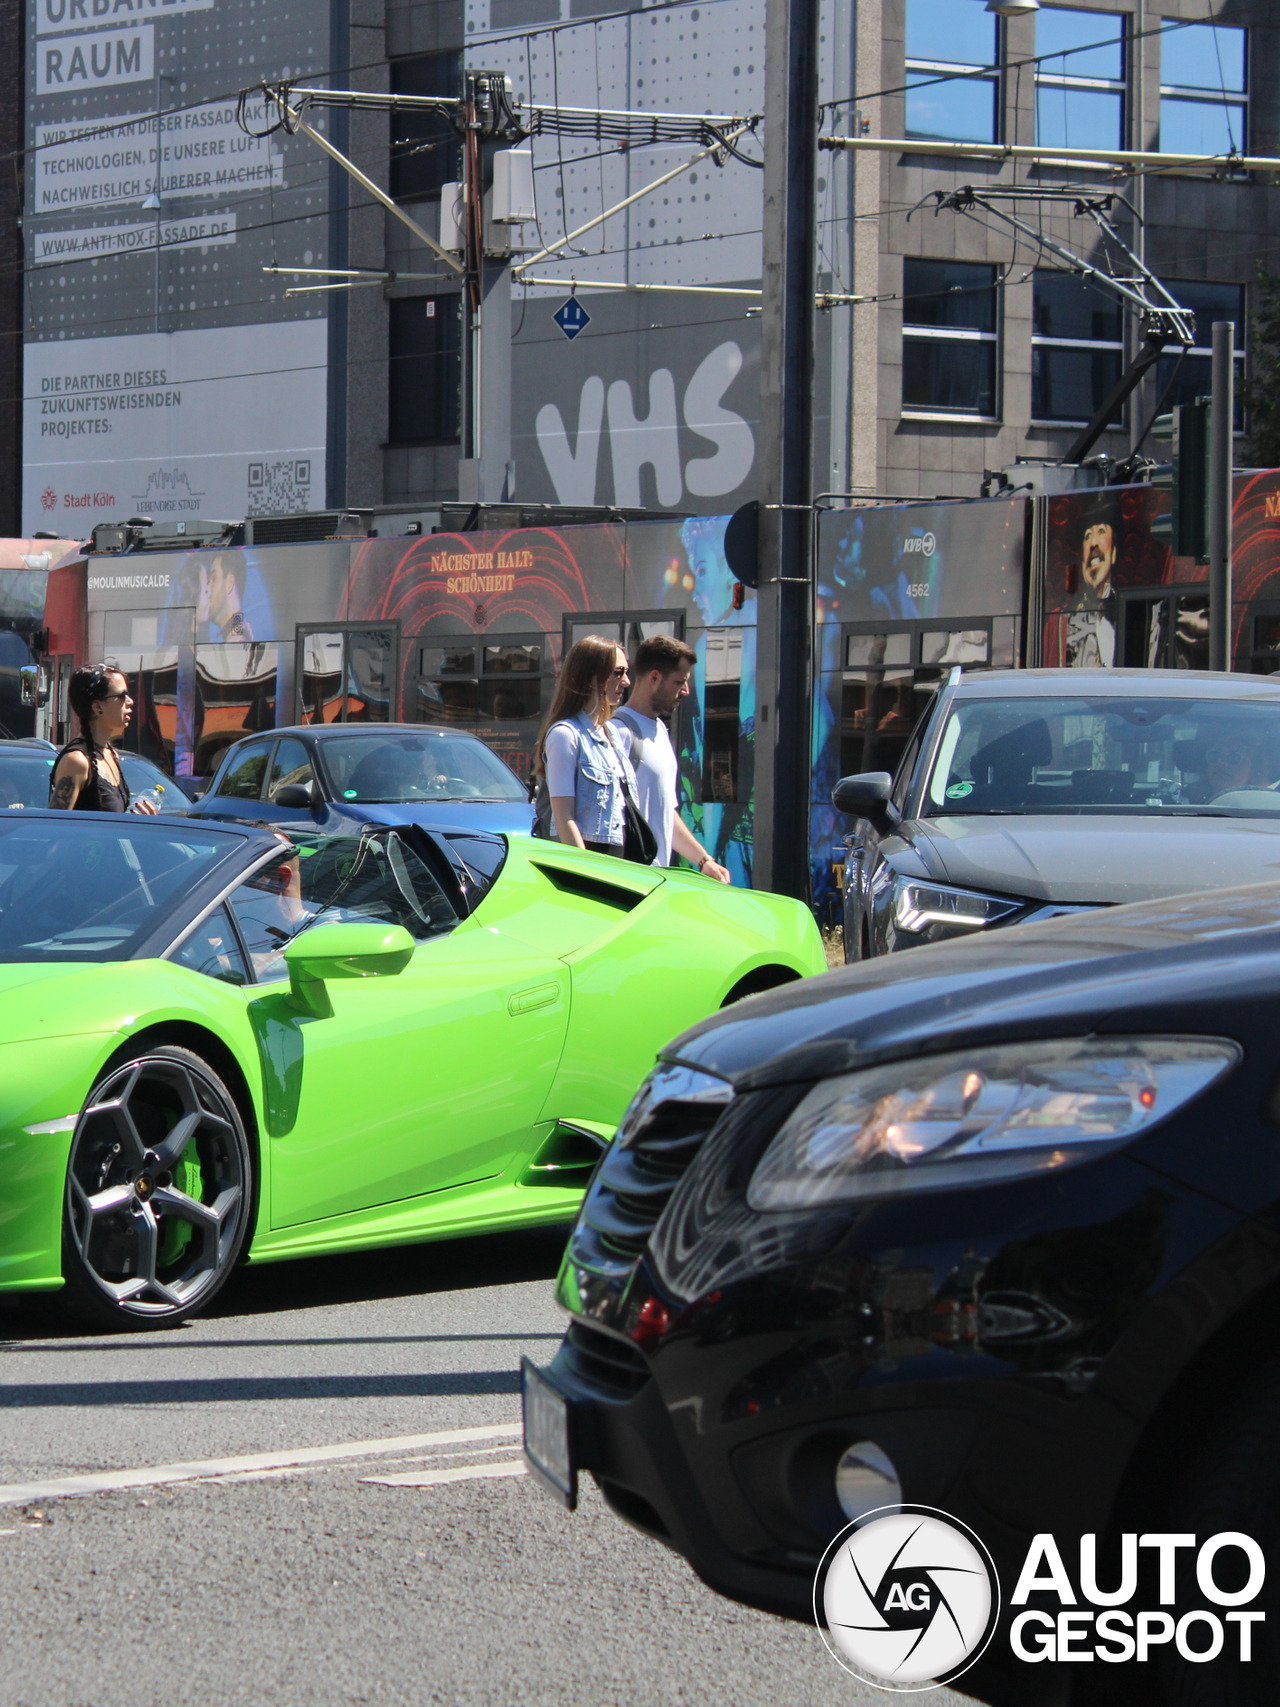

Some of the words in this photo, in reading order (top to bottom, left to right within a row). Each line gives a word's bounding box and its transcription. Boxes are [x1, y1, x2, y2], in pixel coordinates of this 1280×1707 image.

[46, 37, 140, 84] RAUM
[43, 131, 66, 145] WIR
[69, 124, 114, 143] TESTEN
[117, 121, 135, 137] AN
[138, 115, 182, 134] DIESER
[43, 150, 146, 175] TECHNOLOGIEN,
[149, 147, 170, 163] DIE
[174, 140, 225, 160] UNSERE
[230, 137, 261, 153] LUFT
[42, 180, 140, 204] NACHWEISLICH
[145, 171, 211, 194] SAUBERER
[216, 164, 278, 185] MACHEN.
[41, 377, 61, 392] DIE
[65, 373, 120, 390] PARTNER
[124, 369, 167, 386] DIESES
[41, 391, 181, 414] ZUKUNFTSWEISENDEN
[41, 418, 112, 439] PROJEKTES:
[536, 341, 754, 507] VHS
[64, 493, 91, 507] Stadt
[93, 492, 115, 507] Köln
[136, 501, 177, 512] LEBENDIGE
[178, 499, 201, 511] STADT
[903, 538, 922, 553] KVB
[431, 551, 493, 572] NÄCHSTER
[497, 550, 533, 568] HALT:
[87, 574, 170, 590] @MOULINMUSICALDE
[447, 572, 515, 593] SCHÖNHEIT
[906, 583, 930, 597] 4562
